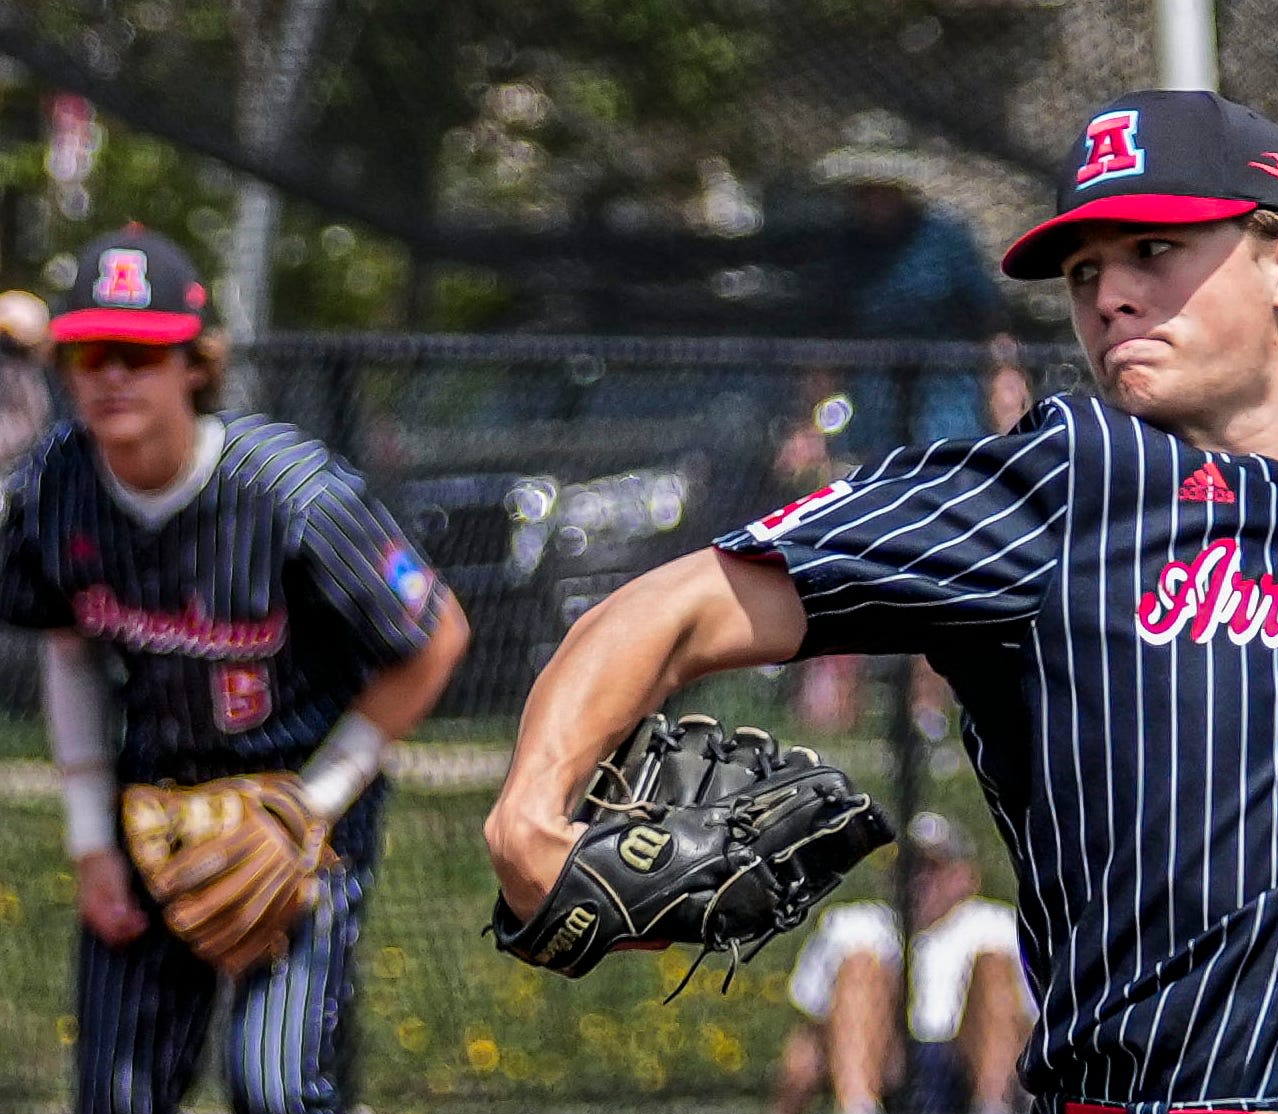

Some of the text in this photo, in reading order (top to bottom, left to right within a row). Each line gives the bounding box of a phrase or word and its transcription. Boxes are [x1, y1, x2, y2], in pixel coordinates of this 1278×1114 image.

[1075, 110, 1145, 190] A
[93, 248, 151, 308] A
[620, 825, 672, 871] W
